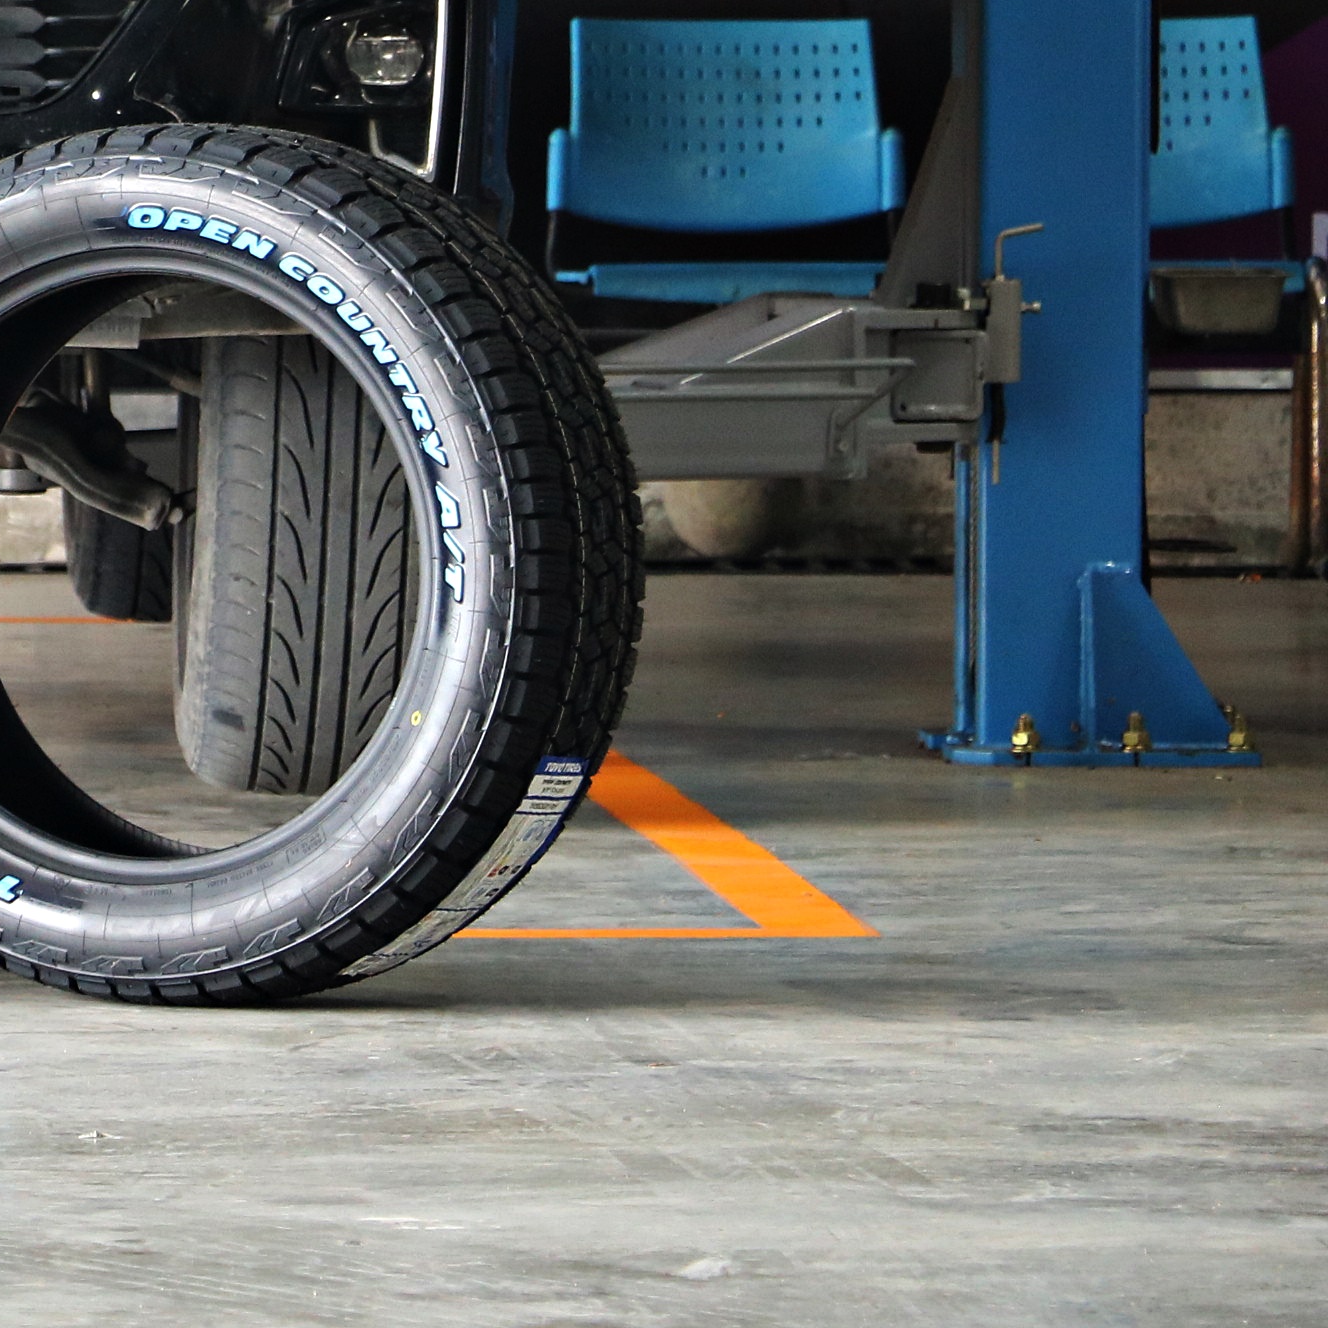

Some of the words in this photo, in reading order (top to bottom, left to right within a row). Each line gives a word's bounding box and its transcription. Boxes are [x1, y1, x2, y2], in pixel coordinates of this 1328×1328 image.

[127, 203, 277, 261] OPEN
[278, 251, 450, 469] COUNTRY
[435, 481, 465, 604] A/T
